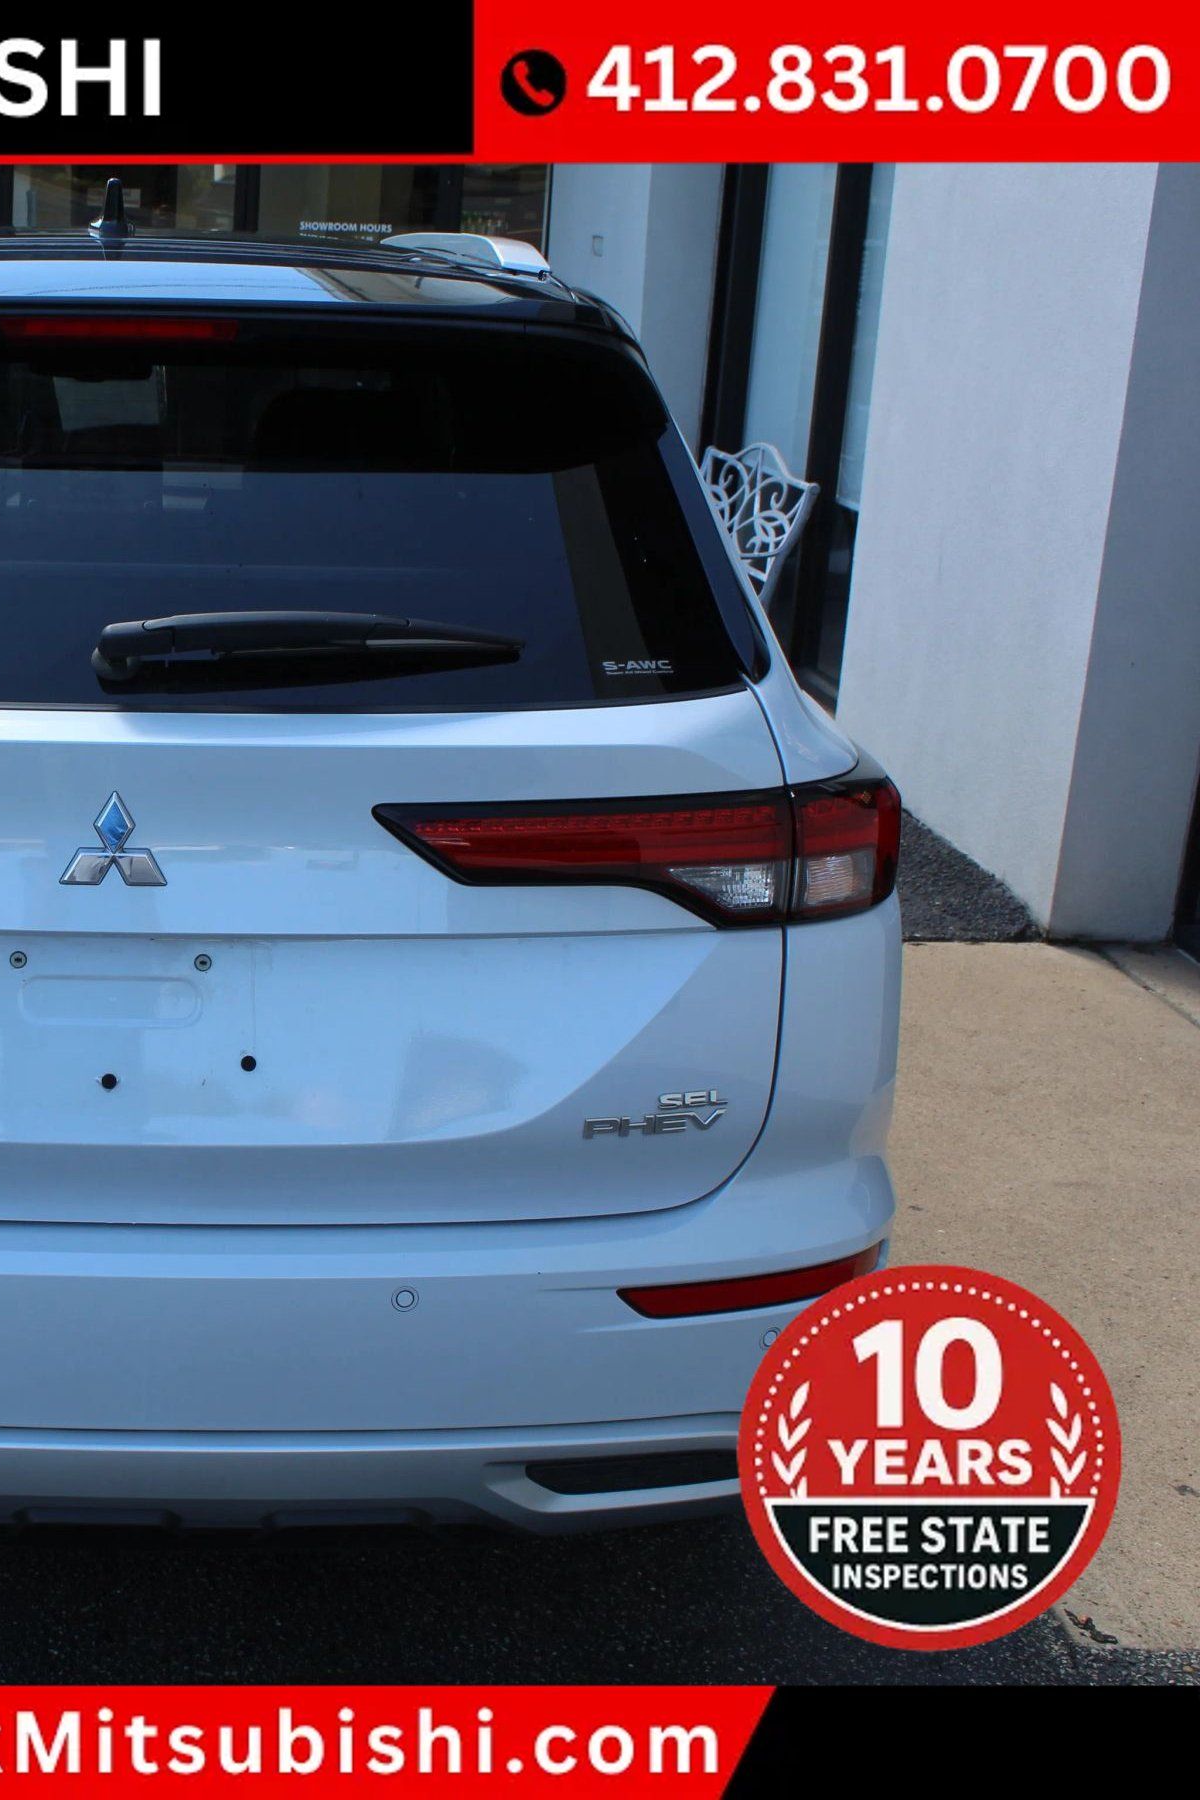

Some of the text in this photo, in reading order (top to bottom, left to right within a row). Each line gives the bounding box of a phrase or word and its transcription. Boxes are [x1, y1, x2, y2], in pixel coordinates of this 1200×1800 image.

[299, 221, 393, 233] SHOWROOM HOURS
[602, 660, 672, 671] S-AWC
[658, 1089, 728, 1109] SEL
[583, 1108, 728, 1139] PHEV
